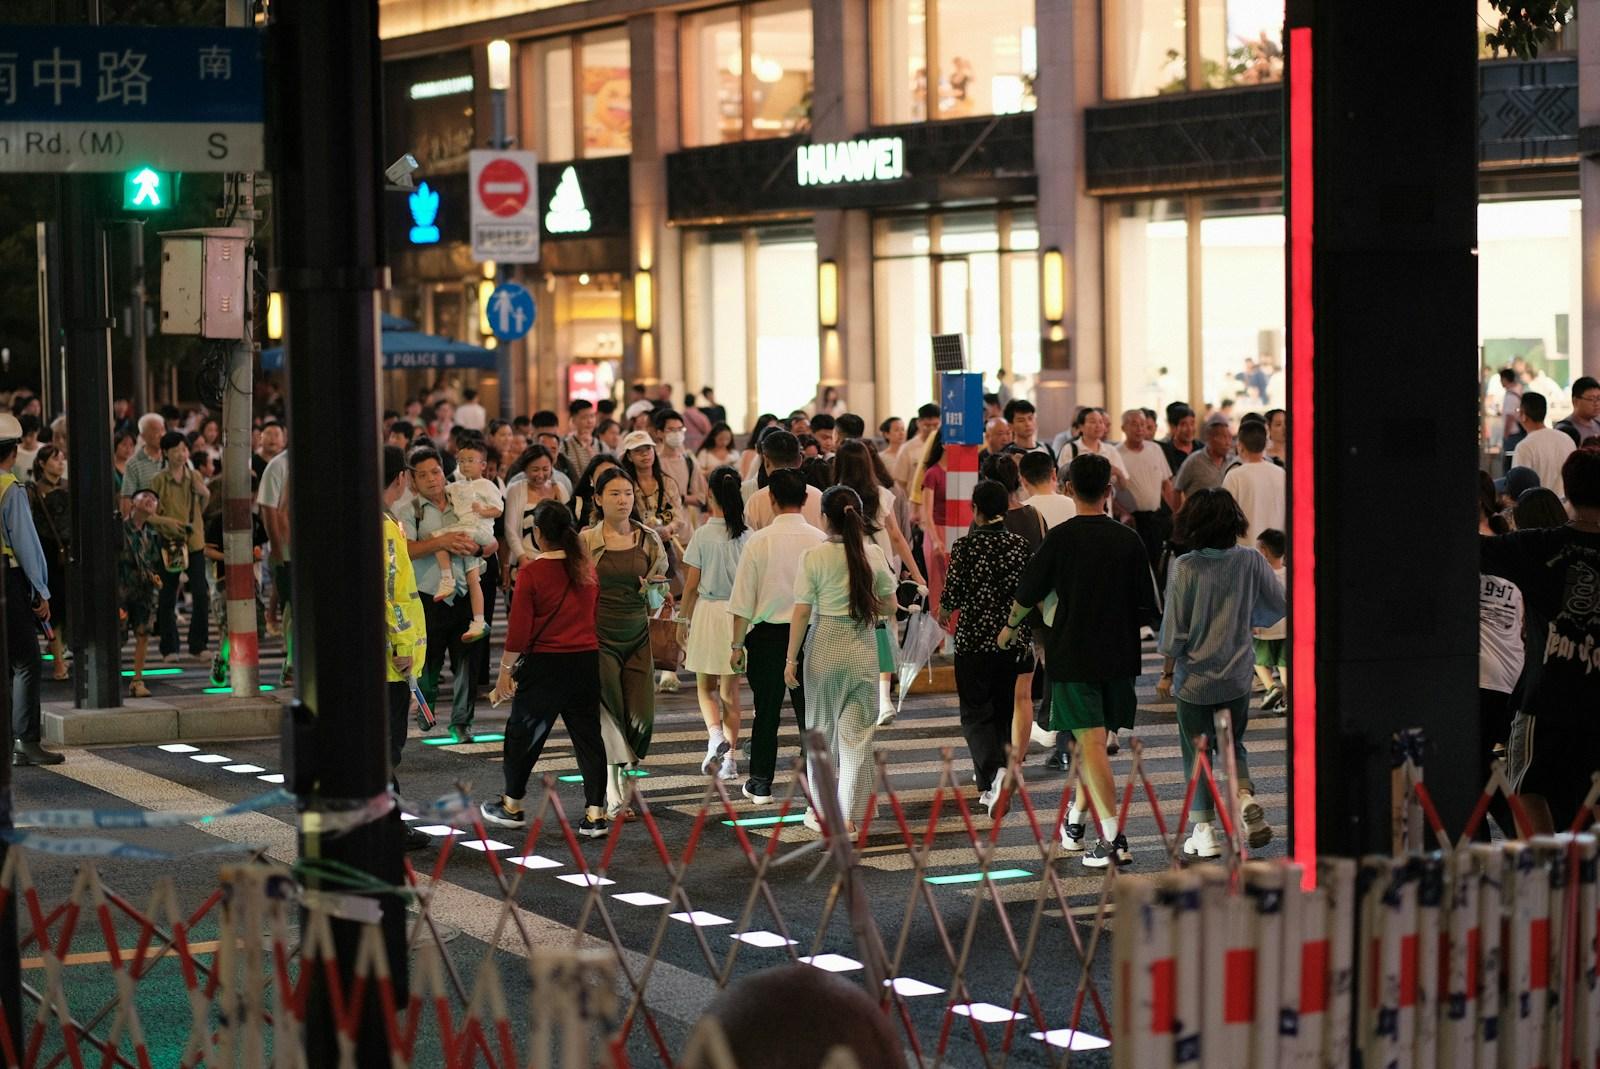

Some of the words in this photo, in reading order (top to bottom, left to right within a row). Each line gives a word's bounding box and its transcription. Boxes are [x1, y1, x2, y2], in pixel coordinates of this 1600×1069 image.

[198, 45, 232, 80] 南
[208, 132, 228, 159] S
[797, 137, 903, 186] HUAWEI
[393, 353, 437, 367] POLICE
